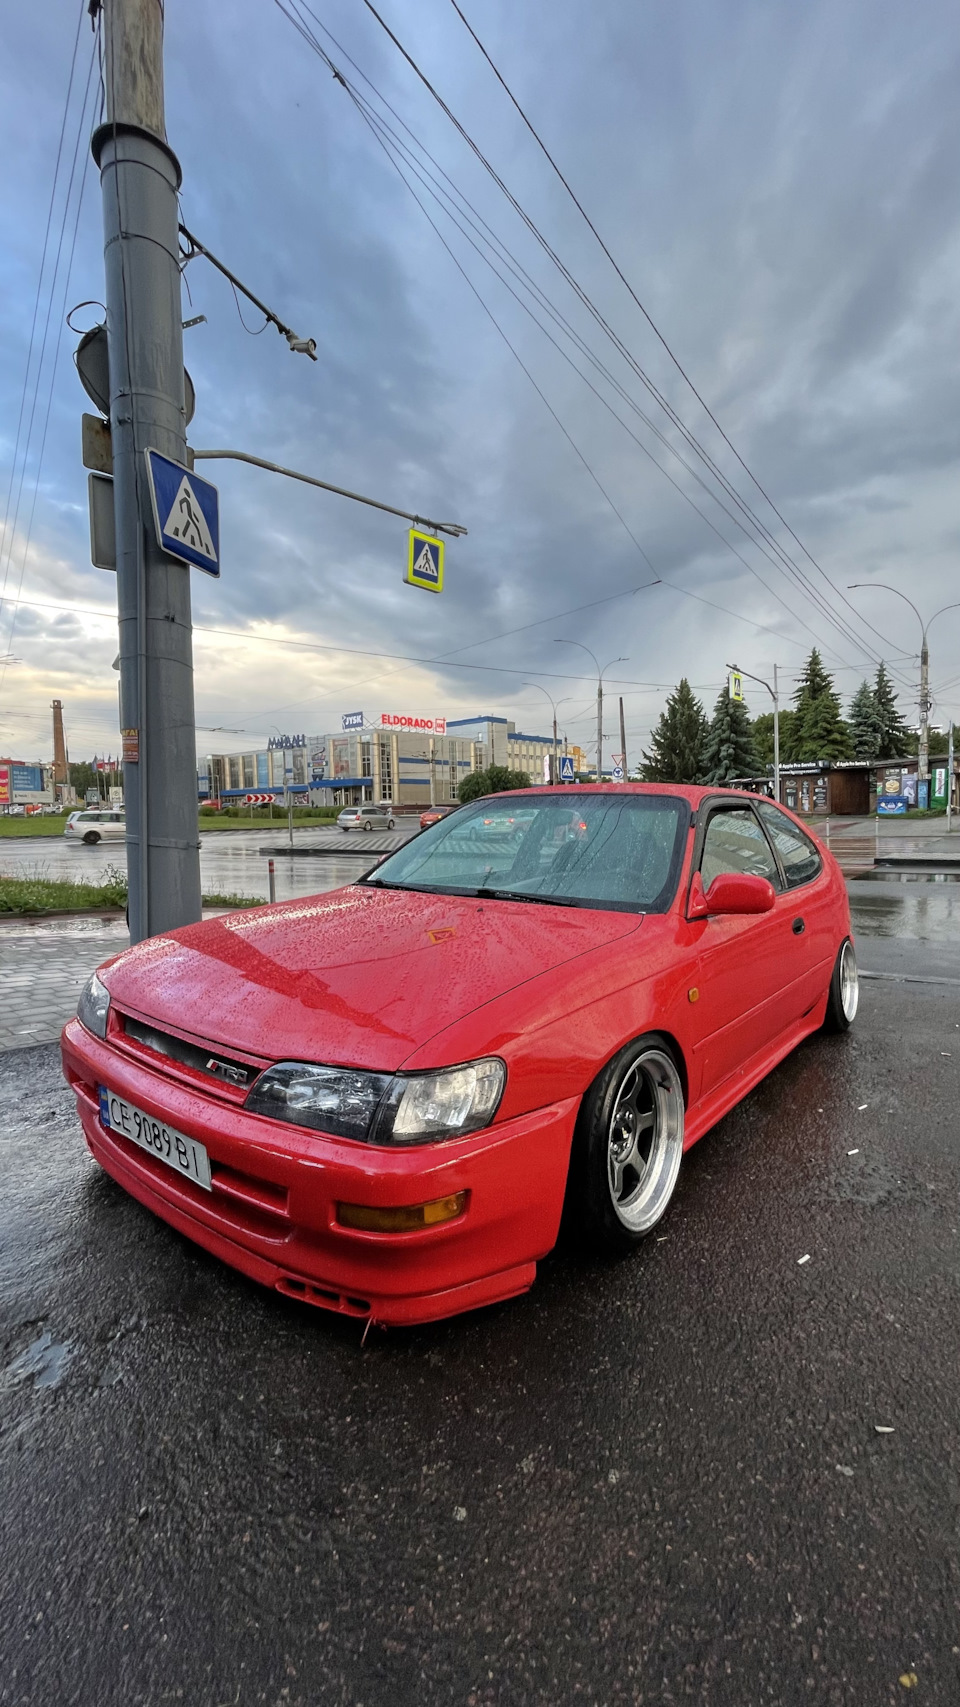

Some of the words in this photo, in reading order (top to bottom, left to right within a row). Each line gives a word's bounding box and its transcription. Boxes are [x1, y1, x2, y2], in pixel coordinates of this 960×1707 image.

[344, 714, 362, 725] JYSK
[381, 714, 433, 729] ELDORADO
[219, 1062, 248, 1082] TRD
[111, 1098, 131, 1133] CE
[133, 1112, 171, 1157] 9089
[175, 1136, 199, 1178] BI
